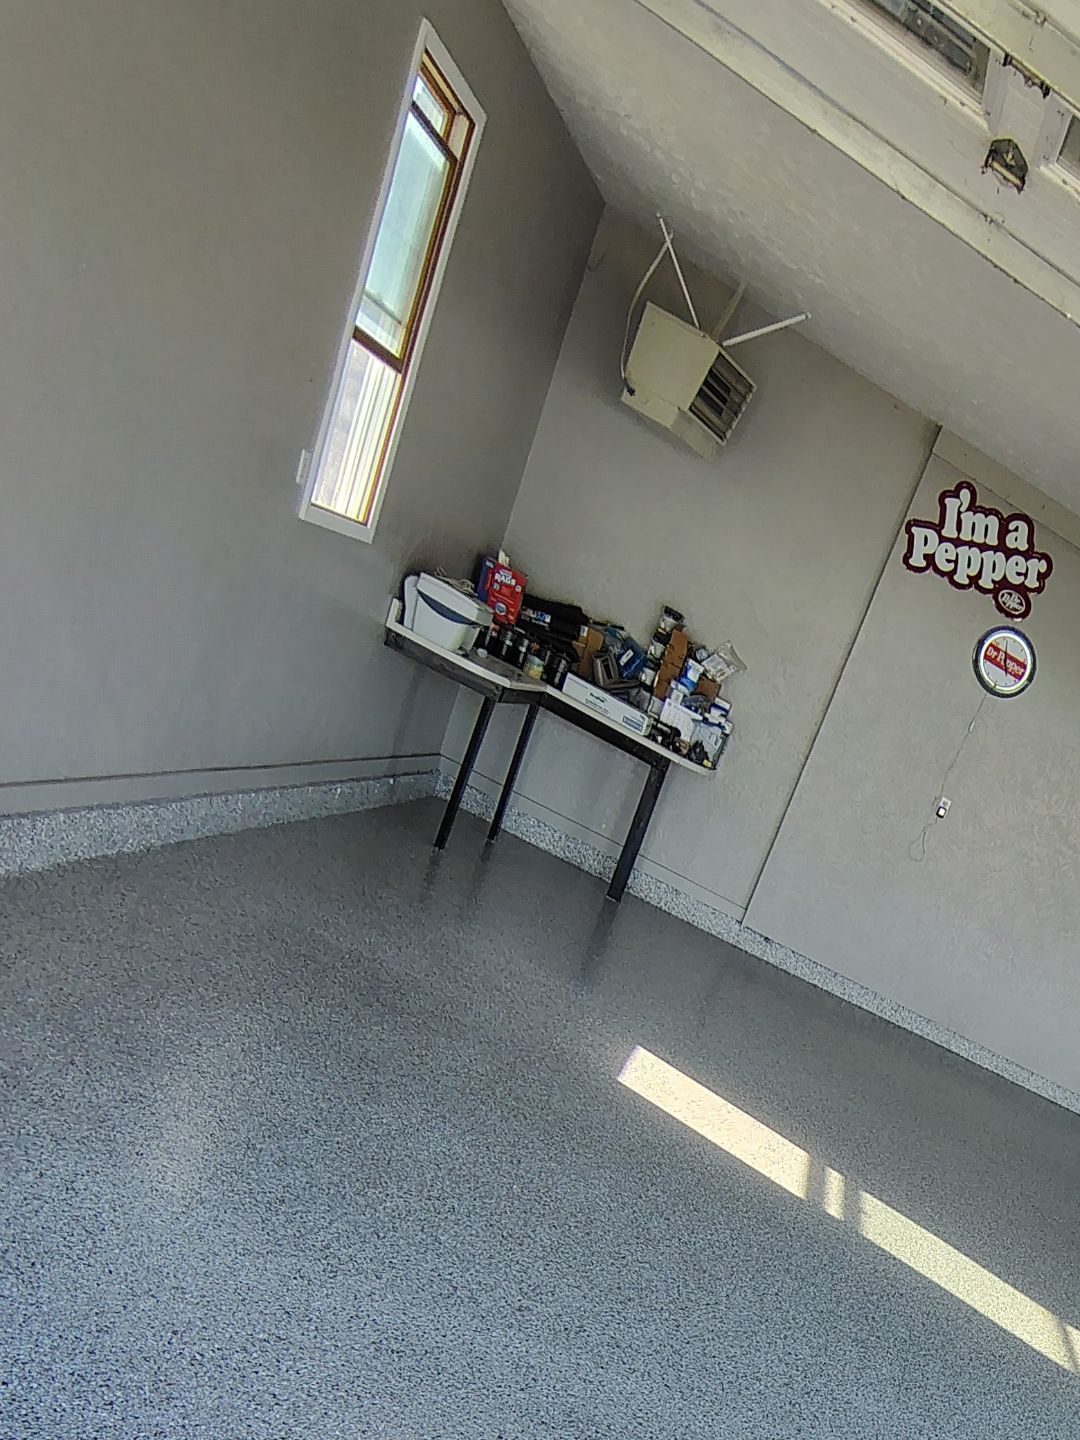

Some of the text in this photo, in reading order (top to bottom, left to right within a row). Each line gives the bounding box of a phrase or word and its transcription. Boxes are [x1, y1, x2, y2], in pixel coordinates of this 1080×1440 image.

[941, 488, 1029, 551] I'm a
[909, 526, 1048, 589] Pepper
[986, 646, 1025, 675] Dr Ppper
